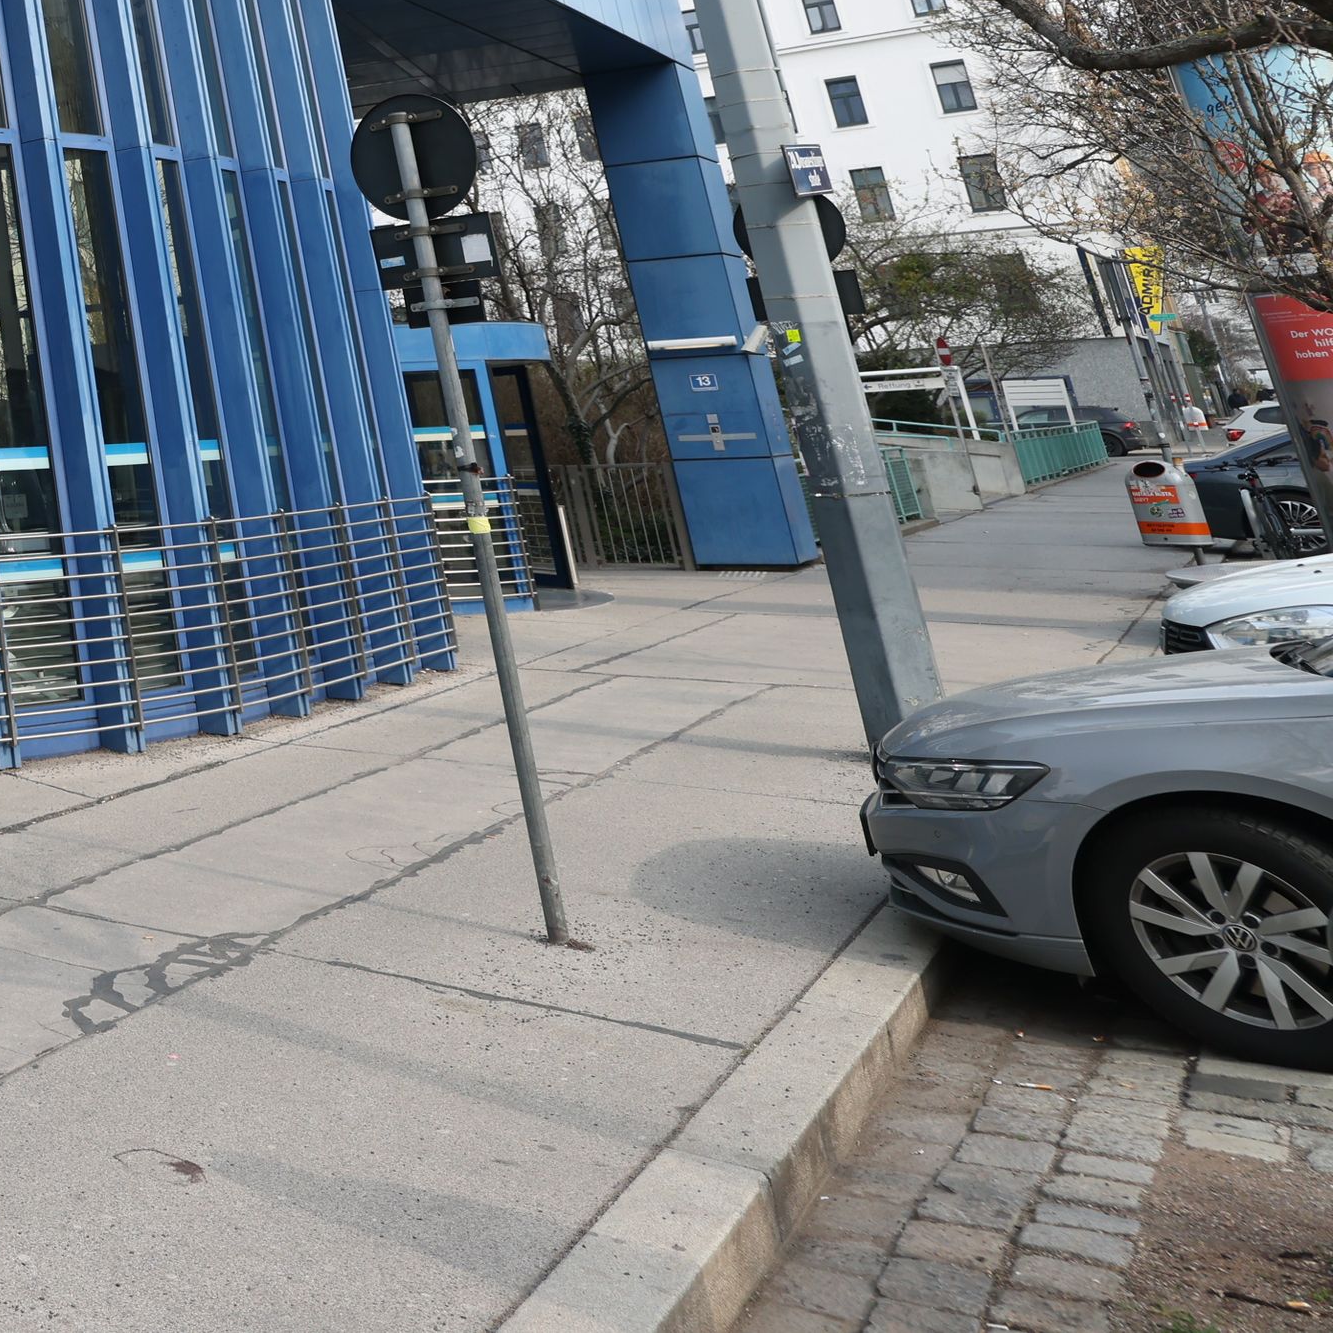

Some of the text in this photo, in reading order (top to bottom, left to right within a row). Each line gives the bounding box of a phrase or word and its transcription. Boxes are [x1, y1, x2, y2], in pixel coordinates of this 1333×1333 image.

[1289, 330, 1309, 339] Der
[1294, 349, 1330, 359] hohen
[695, 376, 712, 387] 13
[877, 382, 911, 390] Rettung
